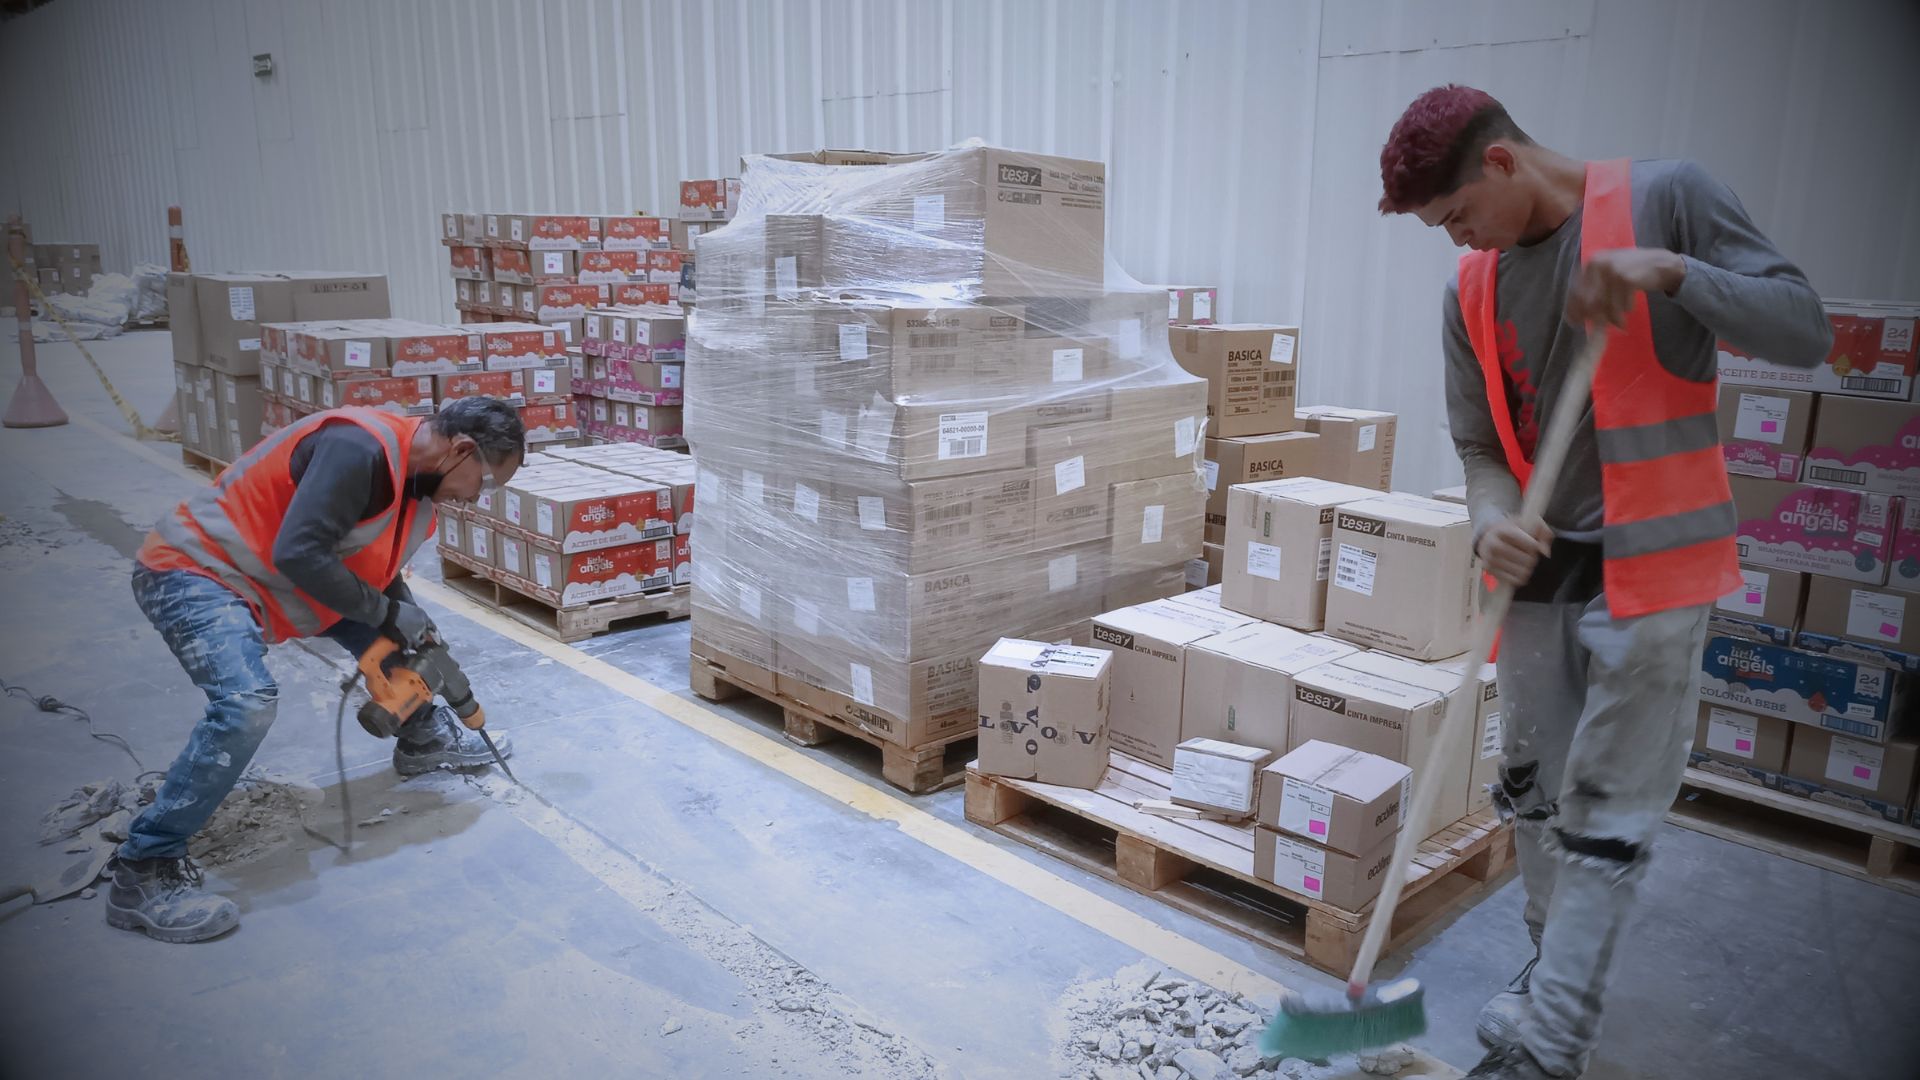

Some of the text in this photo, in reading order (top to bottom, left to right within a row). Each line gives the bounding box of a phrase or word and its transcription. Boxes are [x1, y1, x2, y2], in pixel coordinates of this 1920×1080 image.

[999, 165, 1030, 183] tesa
[1887, 327, 1909, 339] 24
[1228, 349, 1262, 361] BASICA
[1759, 371, 1777, 380] DE
[1250, 459, 1284, 473] BASICA
[1321, 508, 1334, 523] te
[1796, 499, 1833, 517] little
[1339, 514, 1371, 531] tesa
[1779, 511, 1848, 533] angels
[1386, 531, 1436, 548] CINTA IMPRESA
[924, 573, 971, 593] BASICA
[1095, 627, 1122, 644] tesa
[1135, 644, 1177, 663] CINTA IMPRESA
[1731, 645, 1761, 661] little
[927, 656, 973, 678] BASICA
[1717, 654, 1774, 675] angels
[1859, 673, 1880, 687] 24
[1298, 686, 1329, 710] tesa
[1700, 686, 1787, 713] COLONIA BEBÉ
[1346, 709, 1403, 731] CINTA IMPRESA
